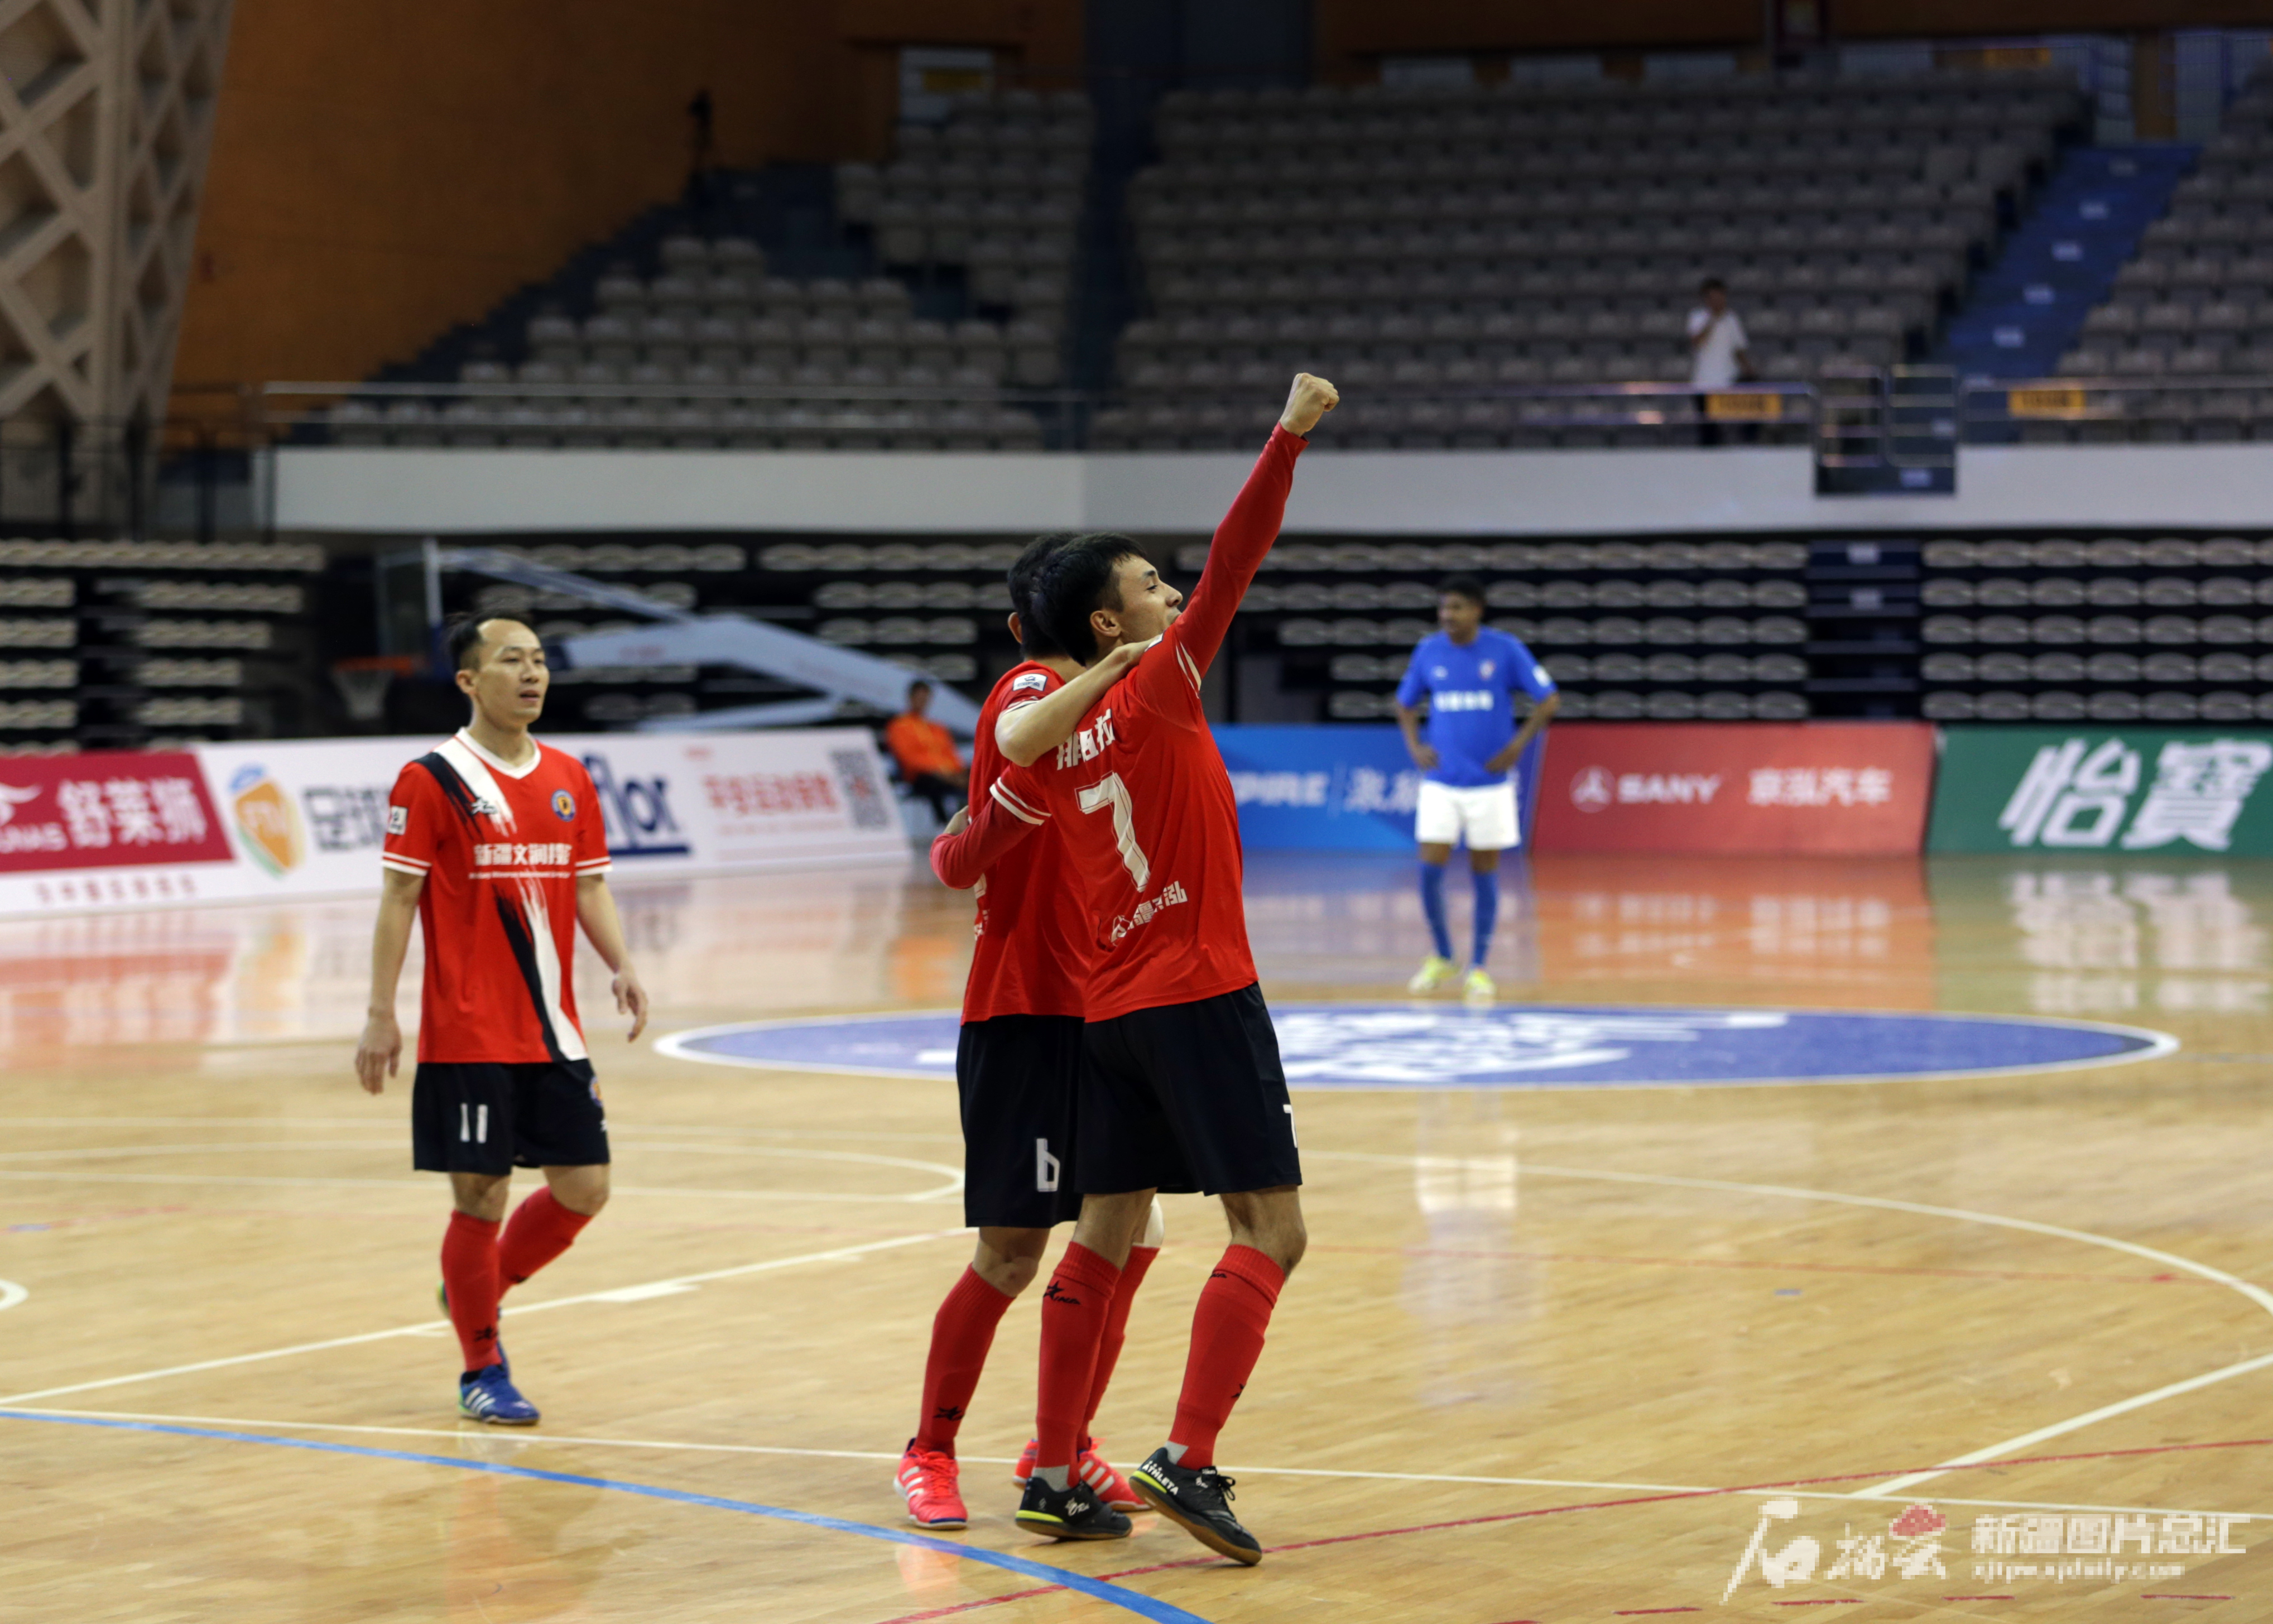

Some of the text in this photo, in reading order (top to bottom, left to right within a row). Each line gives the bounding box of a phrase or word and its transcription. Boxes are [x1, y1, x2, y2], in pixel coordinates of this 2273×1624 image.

[1618, 772, 1722, 805] SANY
[1999, 738, 2271, 851] 怡寶
[1074, 771, 1151, 893] 7
[460, 1102, 488, 1143] 11
[1142, 1460, 1179, 1496] ATHLETA
